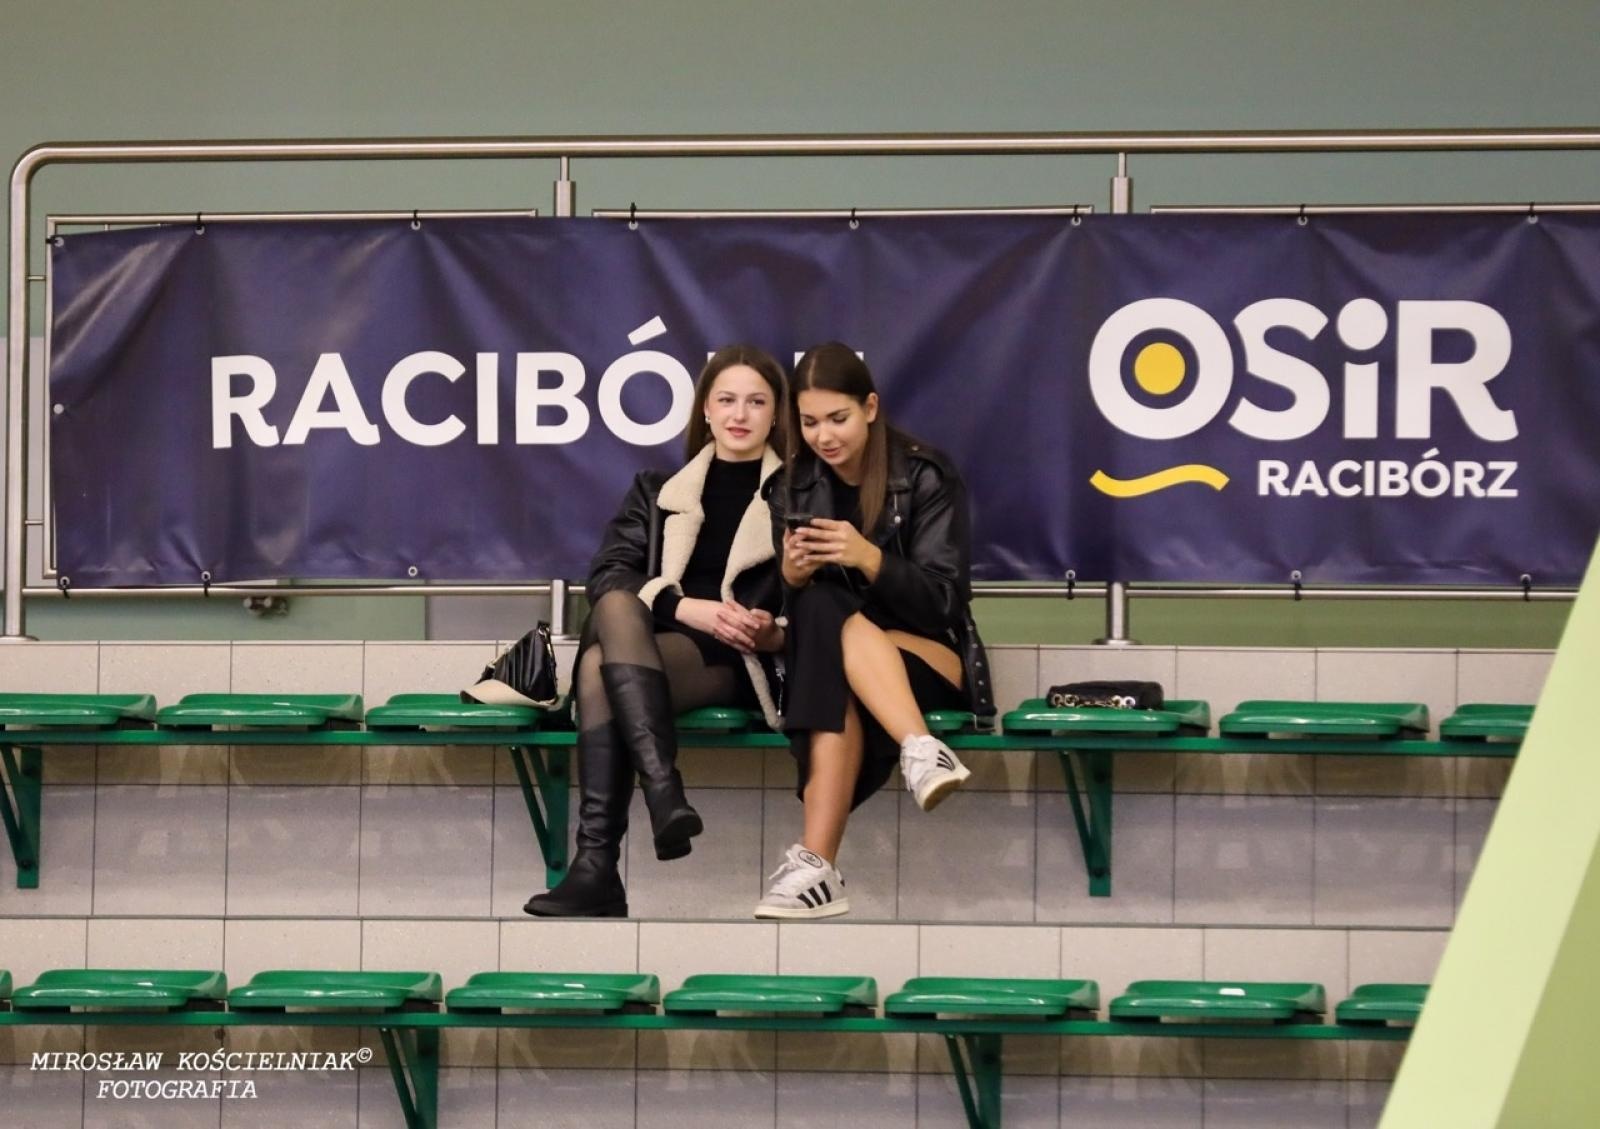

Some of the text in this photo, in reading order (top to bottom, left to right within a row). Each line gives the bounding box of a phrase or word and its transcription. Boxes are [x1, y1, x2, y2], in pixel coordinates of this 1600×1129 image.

[211, 315, 864, 449] RACIBÓ
[1088, 297, 1519, 442] OSiR
[1257, 447, 1518, 498] RACIBÓRZ
